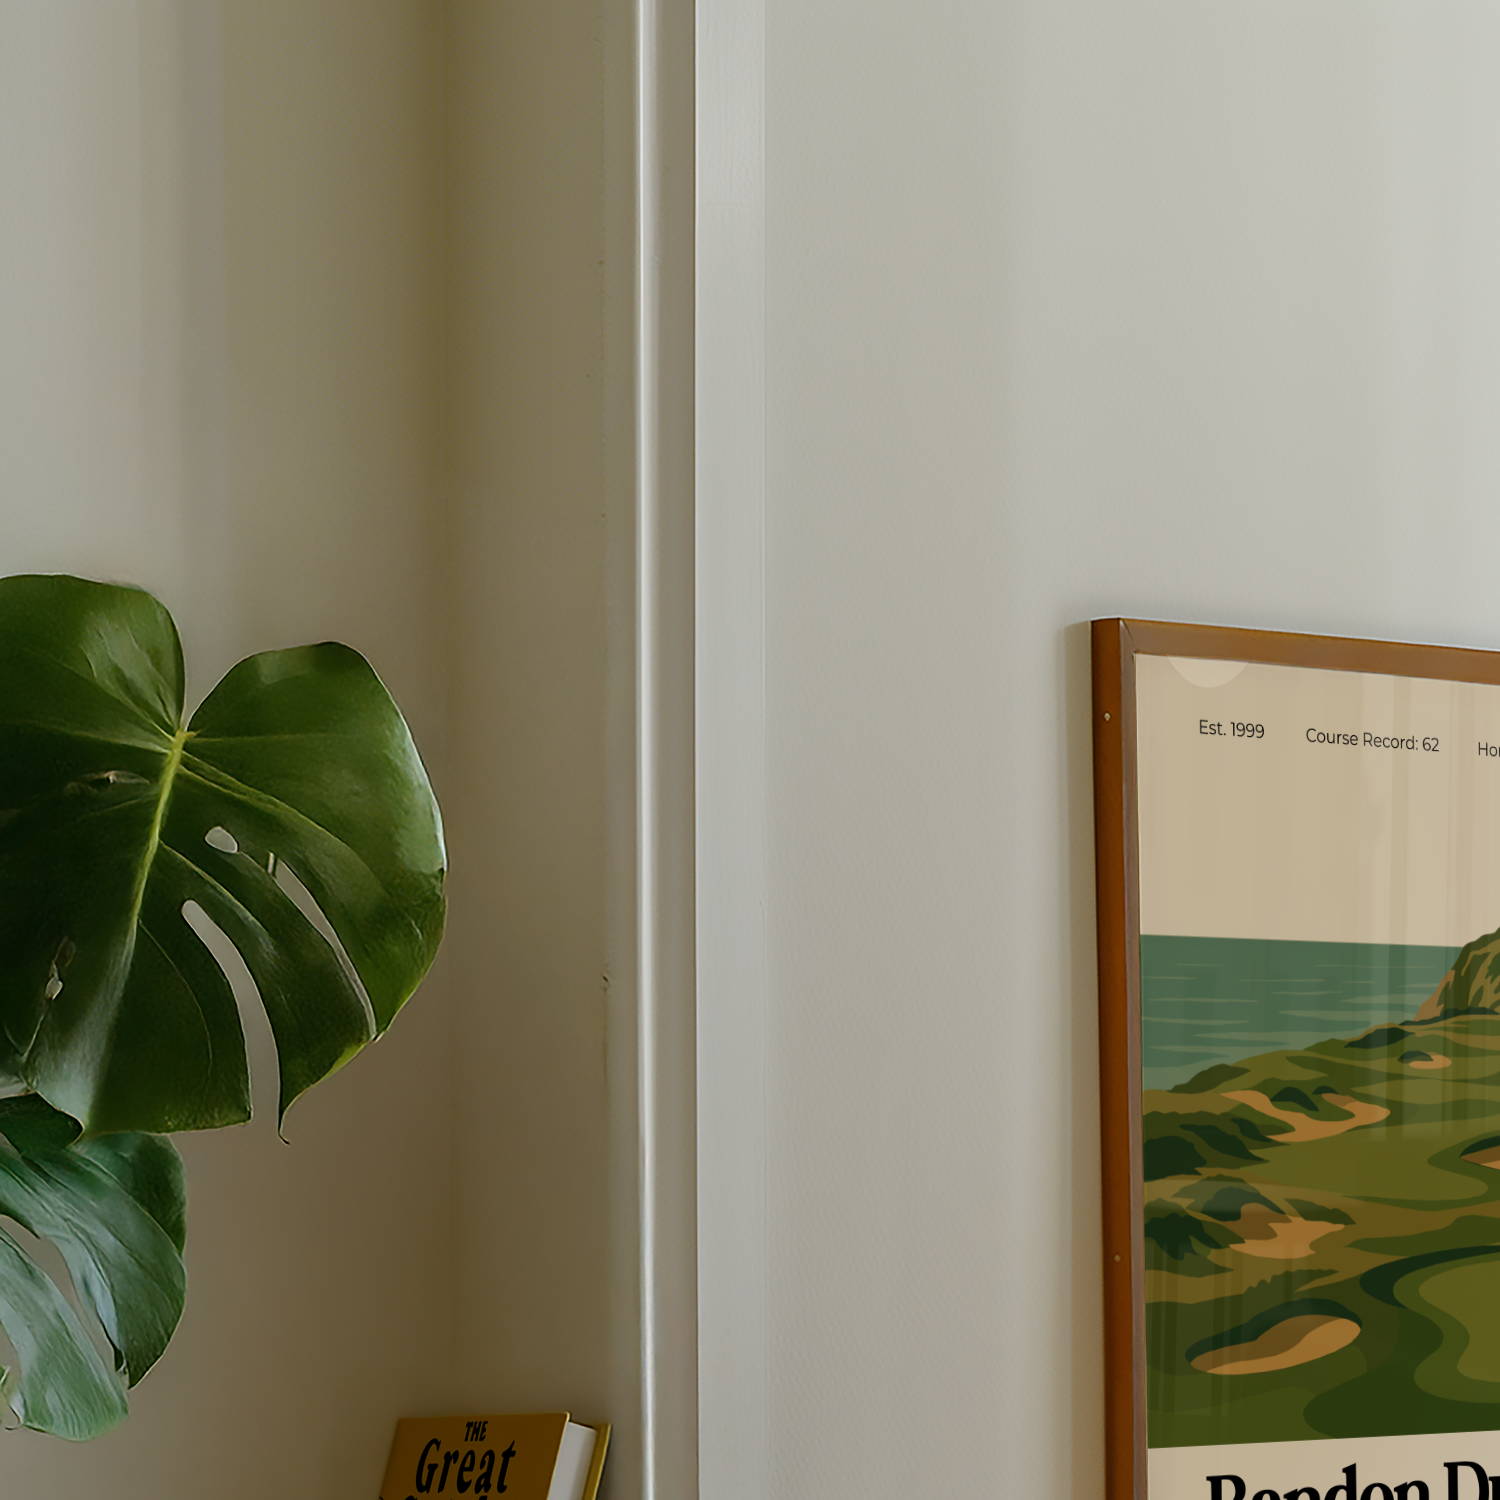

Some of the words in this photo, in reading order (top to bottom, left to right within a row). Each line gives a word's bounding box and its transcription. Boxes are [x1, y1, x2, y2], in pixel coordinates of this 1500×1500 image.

[1199, 719, 1227, 736] Est.
[1230, 721, 1265, 739] 1999
[1305, 727, 1359, 746] Course
[1363, 732, 1419, 751] Record:
[1422, 737, 1440, 752] 62
[464, 1420, 489, 1442] THE
[415, 1437, 517, 1495] Great
